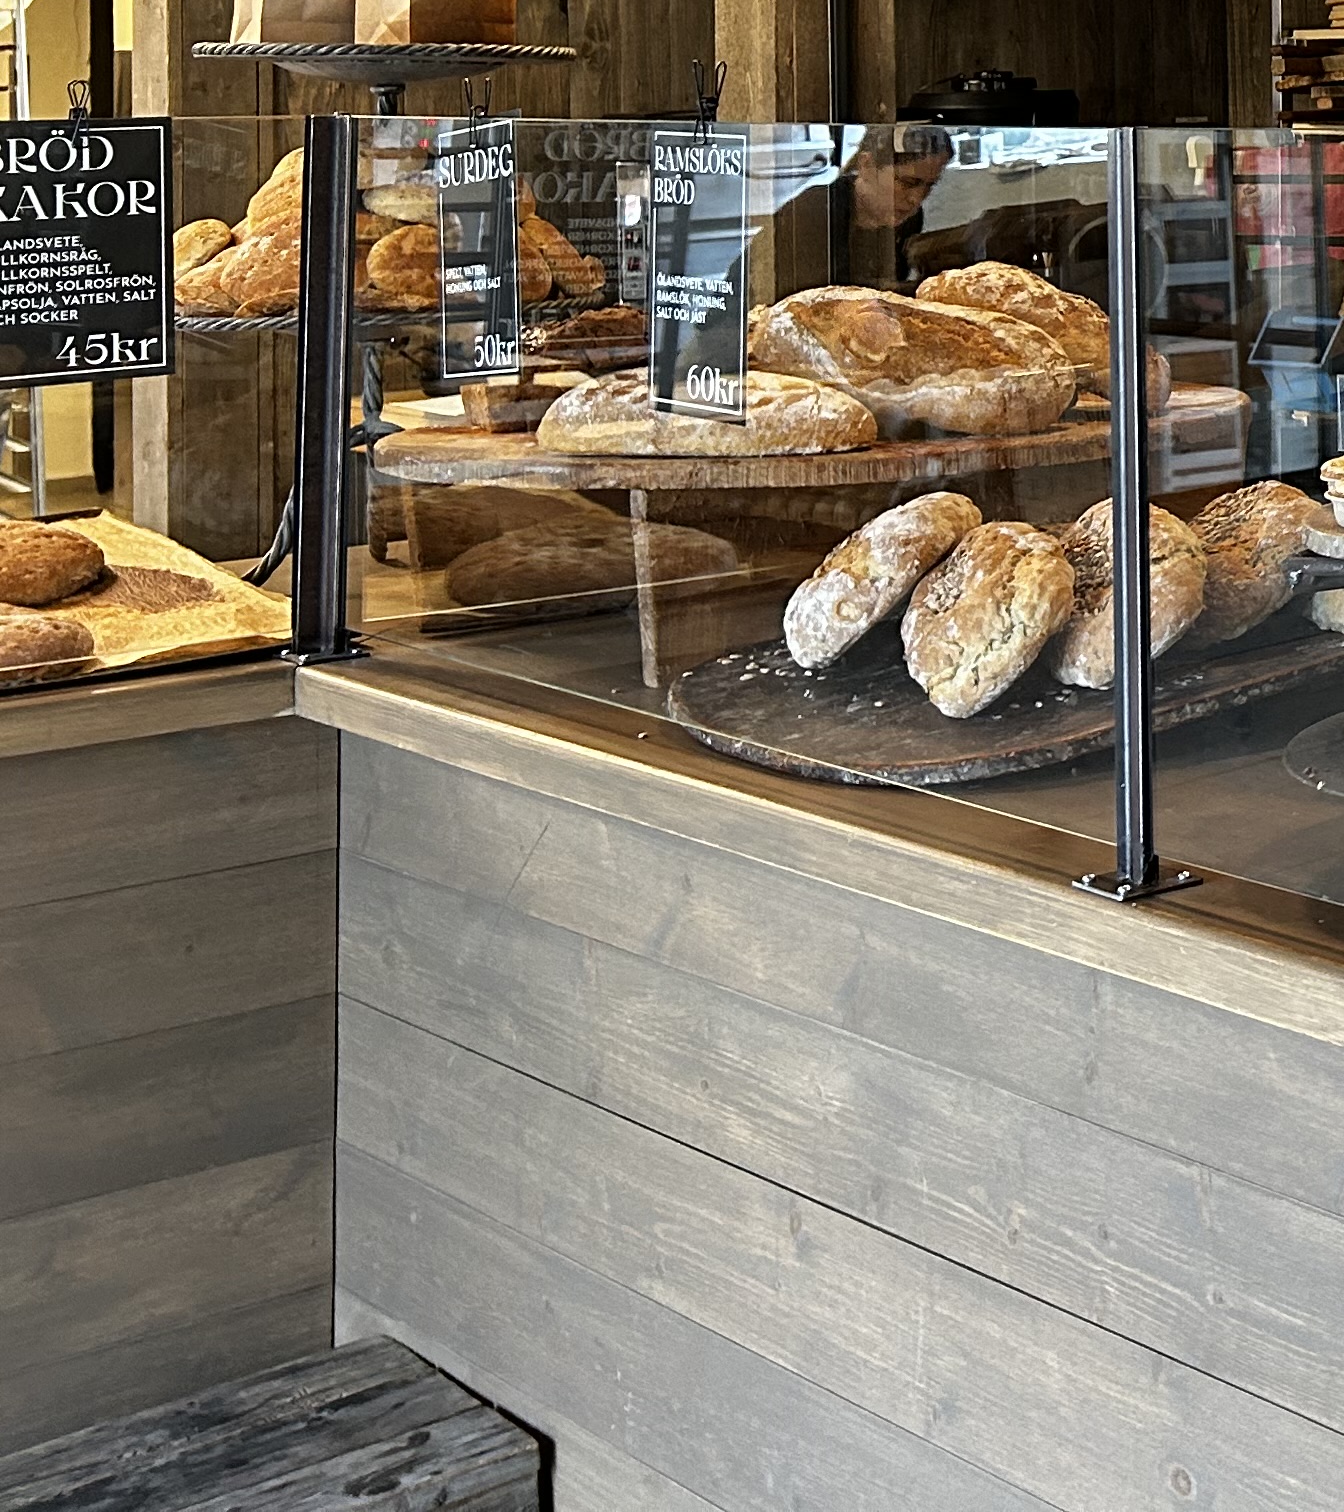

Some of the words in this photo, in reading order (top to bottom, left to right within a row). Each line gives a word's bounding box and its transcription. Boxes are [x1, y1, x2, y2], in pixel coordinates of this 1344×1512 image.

[0, 129, 114, 175] RÖD
[439, 143, 514, 189] SURDEG
[653, 143, 741, 176] RAMSLÖKS
[653, 173, 695, 205] BRÖD
[55, 273, 157, 292] SOLROSFRÖN,
[62, 291, 120, 306] VATTEN,
[123, 288, 157, 303] SALT
[20, 309, 79, 325] SOCKER
[655, 305, 673, 319] SALT
[55, 331, 158, 368] 45kr
[474, 334, 516, 369] 50kr
[686, 364, 739, 406] 60kr
